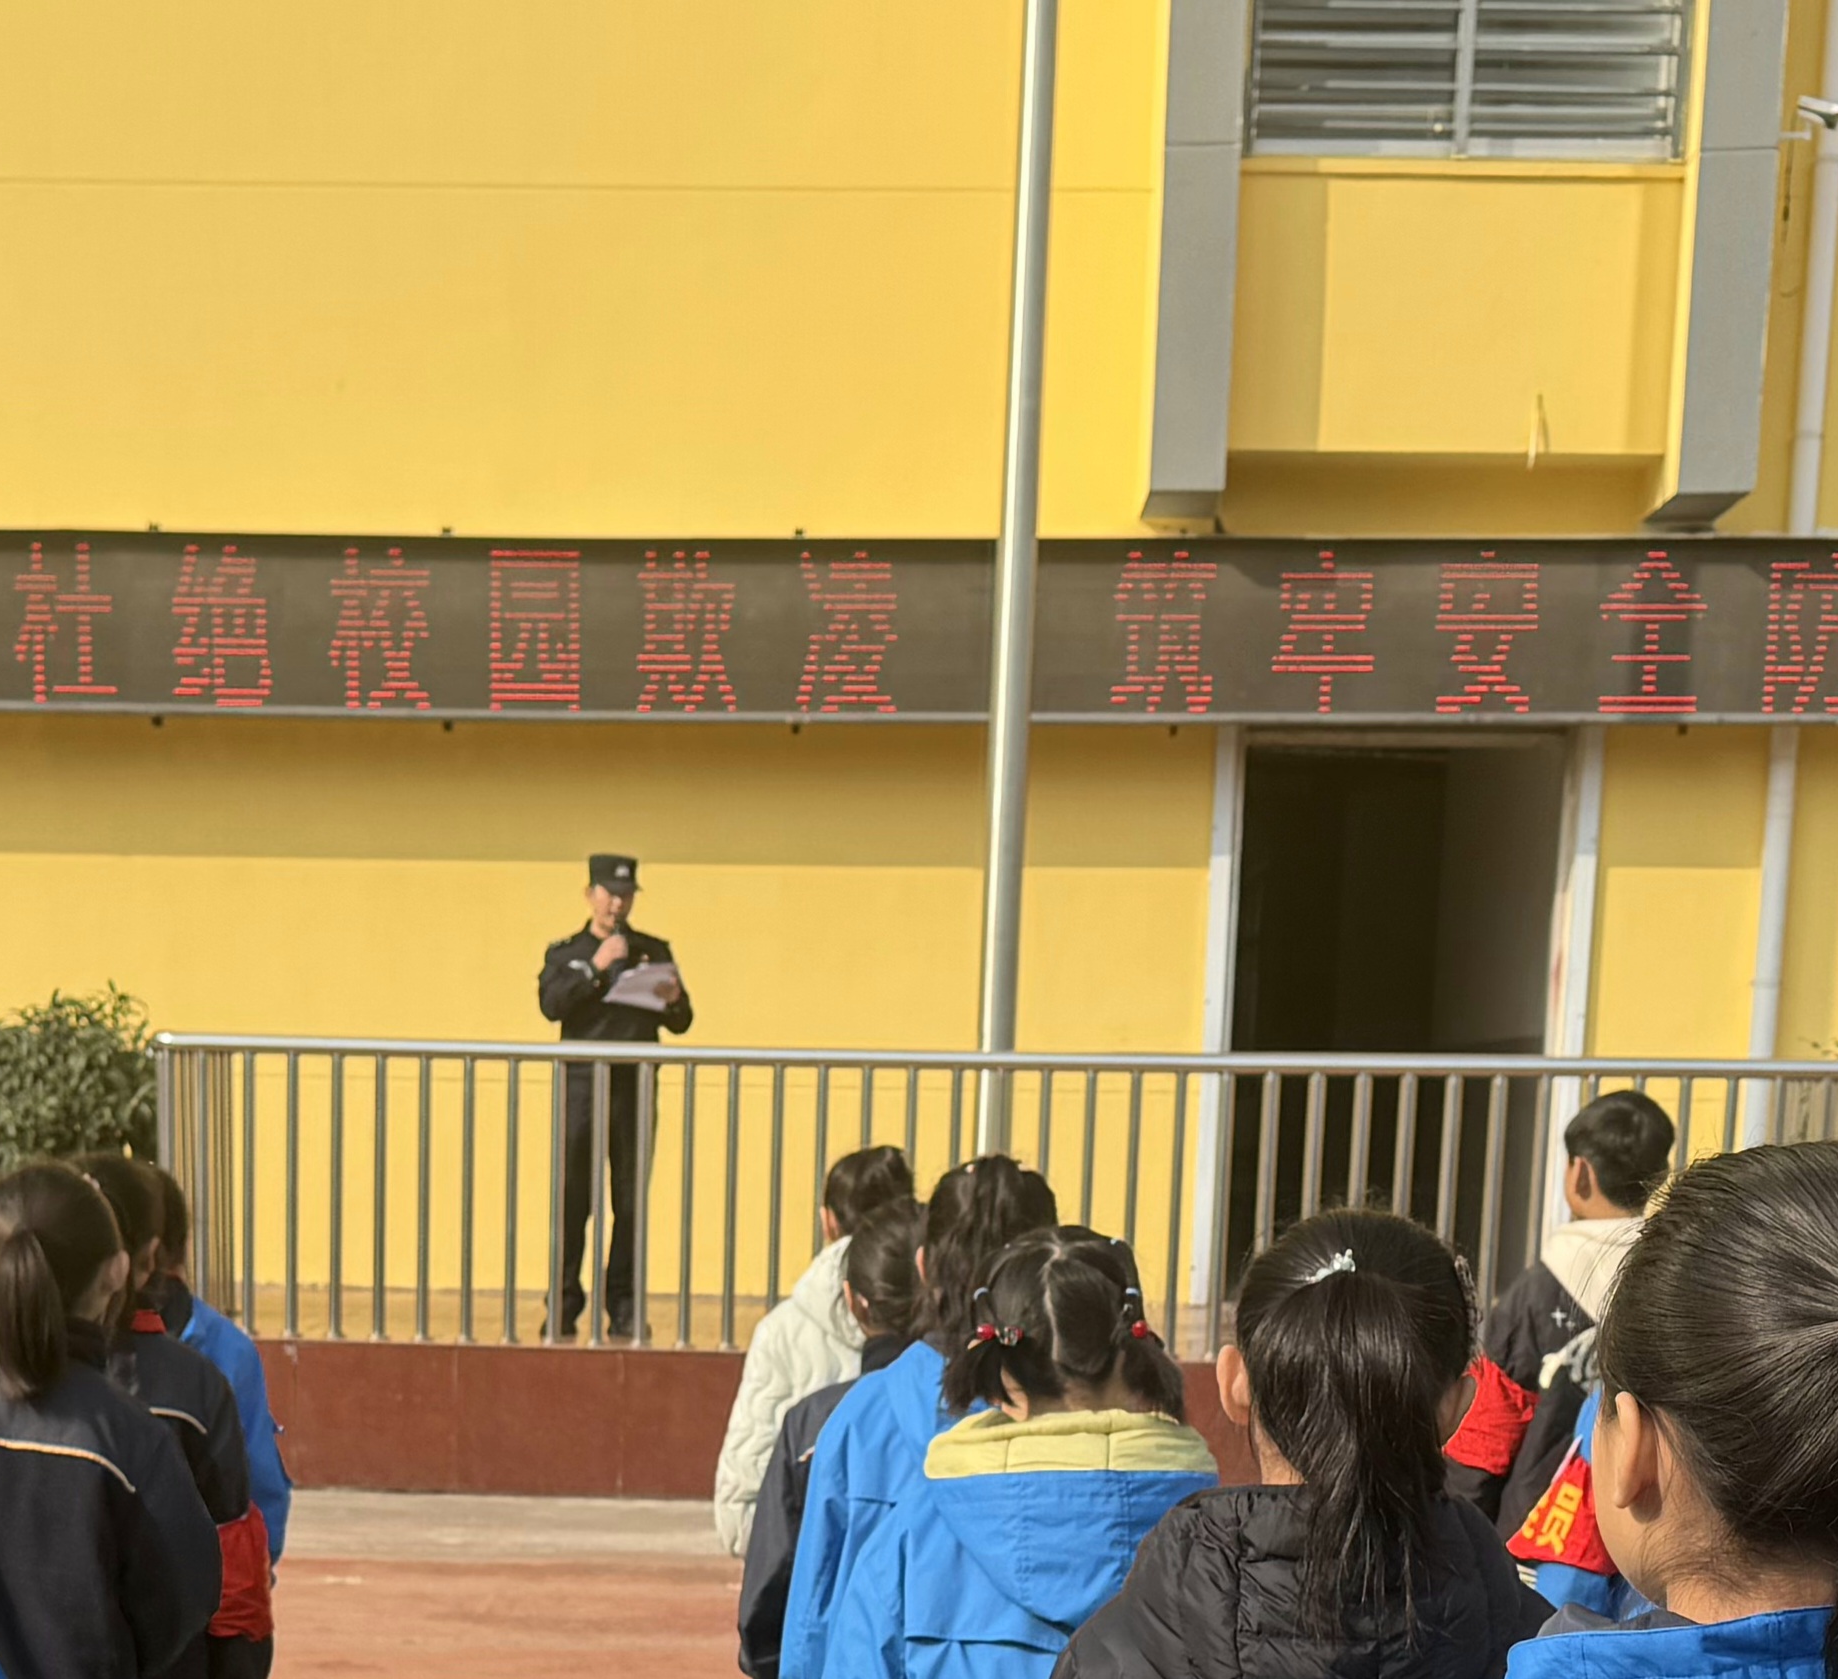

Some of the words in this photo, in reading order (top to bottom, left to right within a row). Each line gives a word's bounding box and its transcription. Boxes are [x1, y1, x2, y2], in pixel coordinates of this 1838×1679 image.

[14, 542, 898, 714] 杜绝校园欺凌
